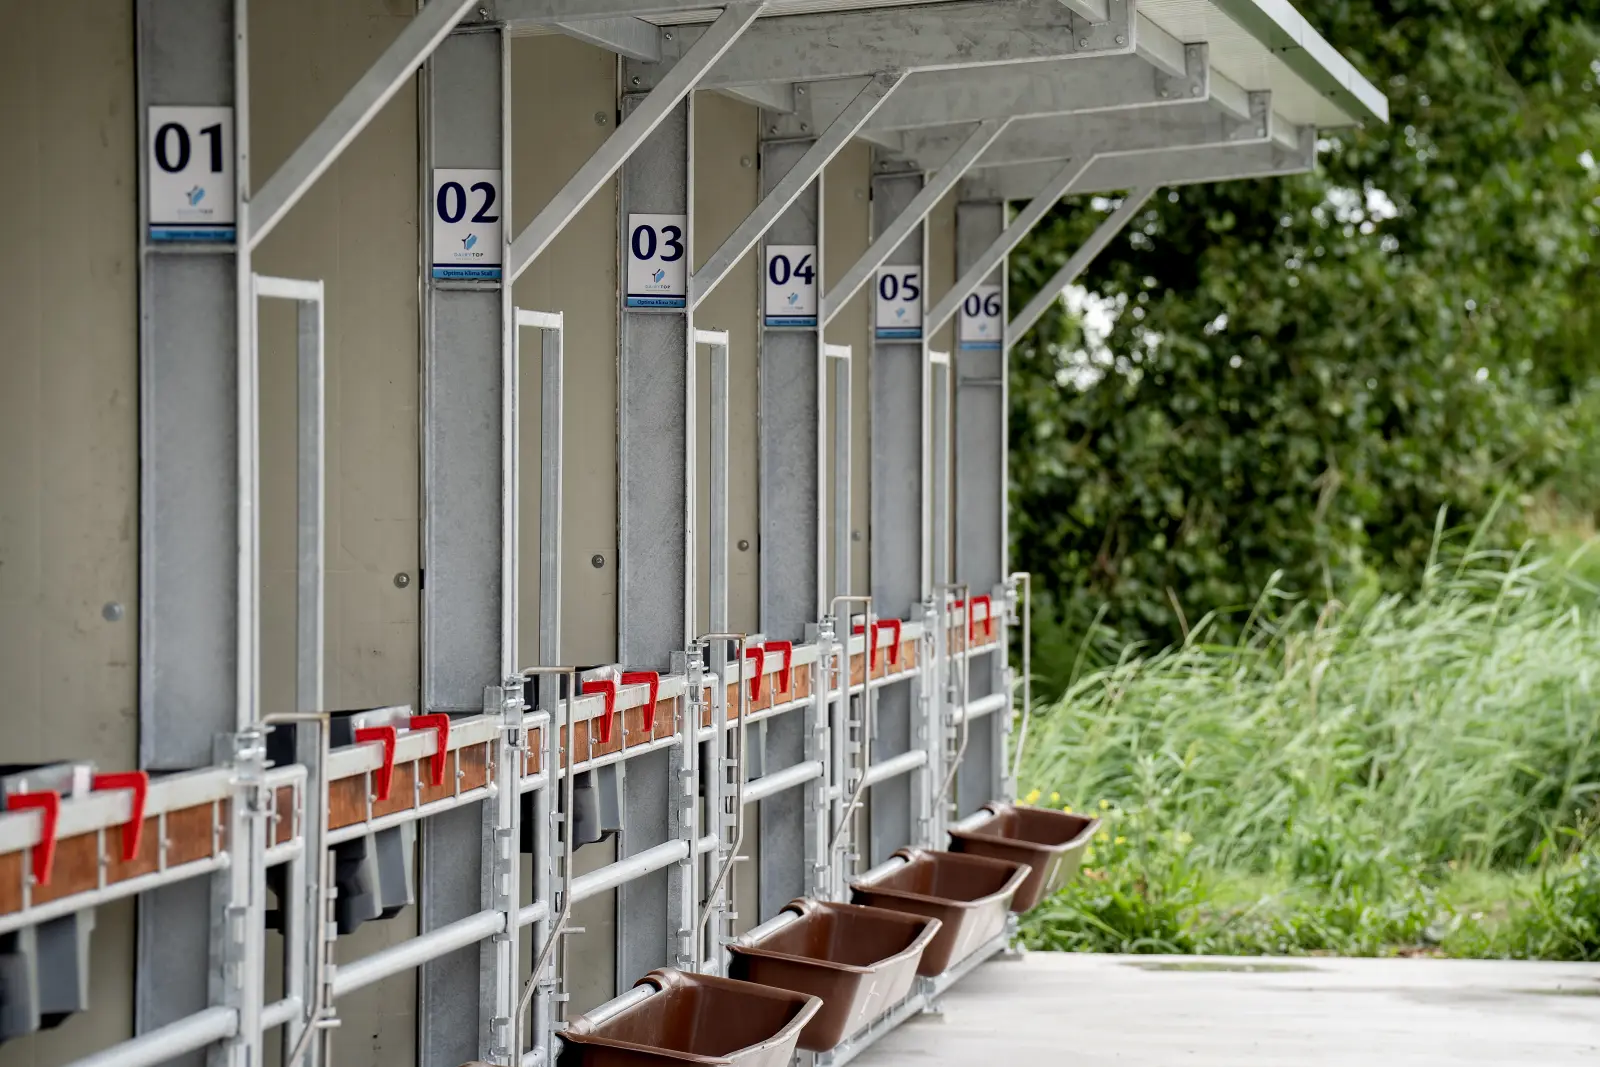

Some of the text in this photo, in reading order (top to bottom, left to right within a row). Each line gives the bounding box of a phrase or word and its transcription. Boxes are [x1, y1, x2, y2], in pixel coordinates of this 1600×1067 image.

[154, 122, 223, 174] 01
[437, 181, 499, 224] 02
[631, 224, 684, 262] 03
[769, 253, 816, 286] 04
[879, 273, 920, 302] 05
[964, 292, 1000, 318] 06
